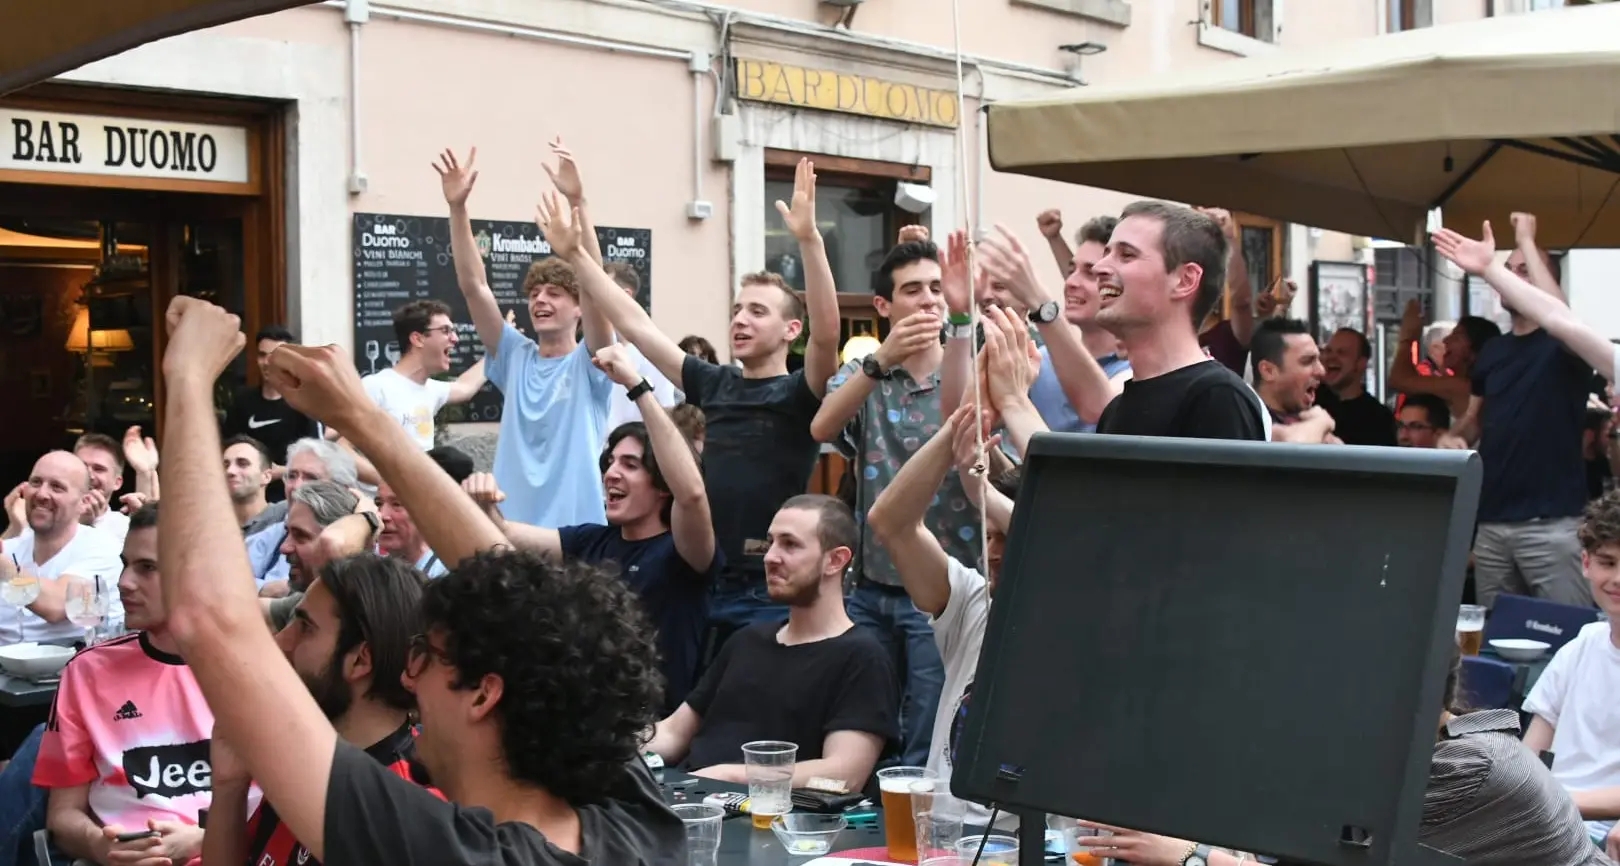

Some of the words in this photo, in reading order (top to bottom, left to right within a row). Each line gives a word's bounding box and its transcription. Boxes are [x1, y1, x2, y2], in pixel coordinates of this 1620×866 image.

[744, 60, 821, 104] BAR
[837, 74, 957, 124] DUOMO
[11, 118, 82, 164] BAR
[104, 126, 216, 172] DUOMO
[374, 224, 396, 235] BAR
[362, 233, 409, 248] Duomo
[617, 237, 635, 247] BAR
[363, 249, 386, 260] VINI
[607, 244, 645, 258] Duomo
[133, 755, 212, 788] Jee
